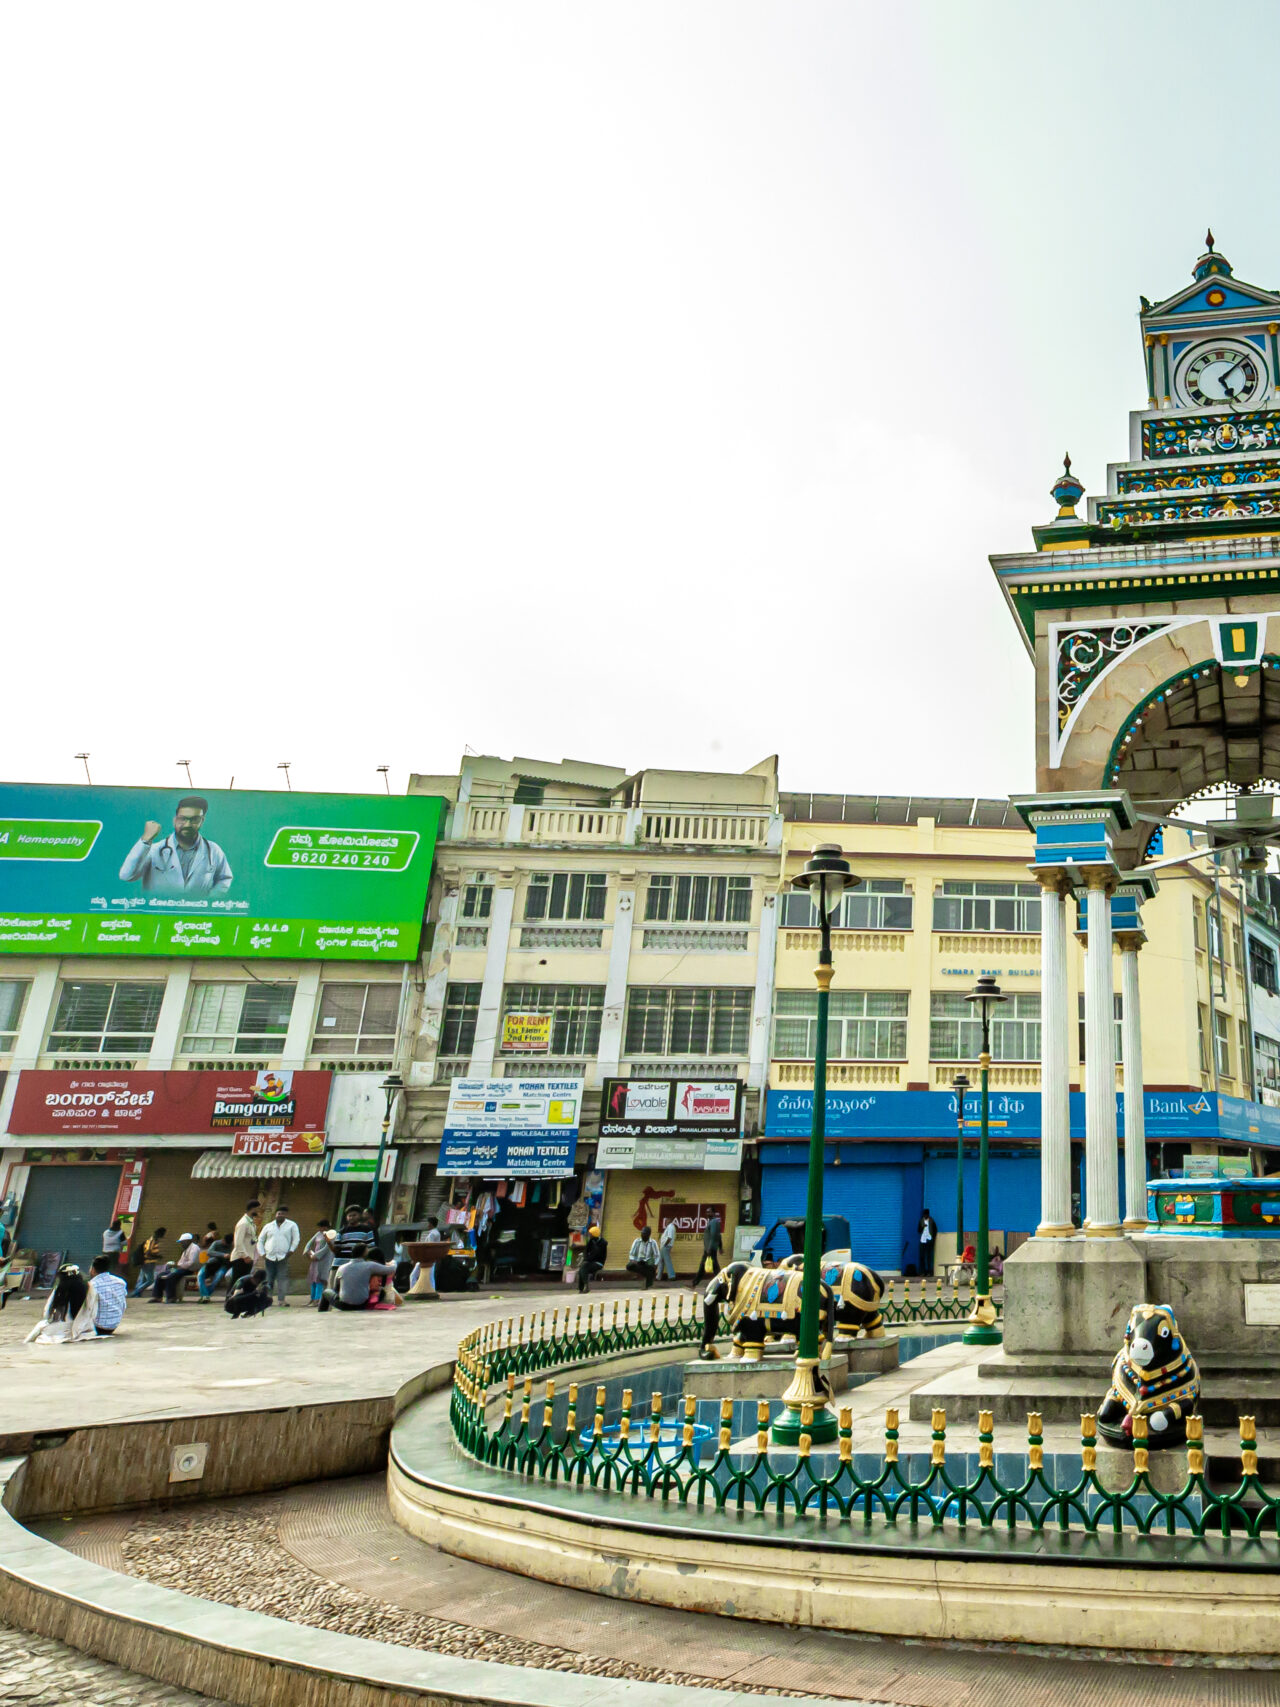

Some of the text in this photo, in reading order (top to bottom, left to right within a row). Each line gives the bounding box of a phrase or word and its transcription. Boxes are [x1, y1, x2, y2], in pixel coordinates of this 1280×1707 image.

[18, 835, 85, 847] Homeopathy
[292, 852, 390, 866] 9620 240 240
[941, 968, 974, 976] CANARA
[507, 1016, 550, 1026] FOR RENT
[547, 1082, 578, 1090] TEXTILES
[626, 1097, 667, 1108] Lovable
[1150, 1099, 1189, 1114] Bank
[214, 1101, 294, 1117] Bangarpet
[239, 1134, 265, 1142] FRESH
[238, 1141, 294, 1154] JUICE
[507, 1146, 569, 1156] MOHAN TEXTILES
[507, 1159, 540, 1168] Matching
